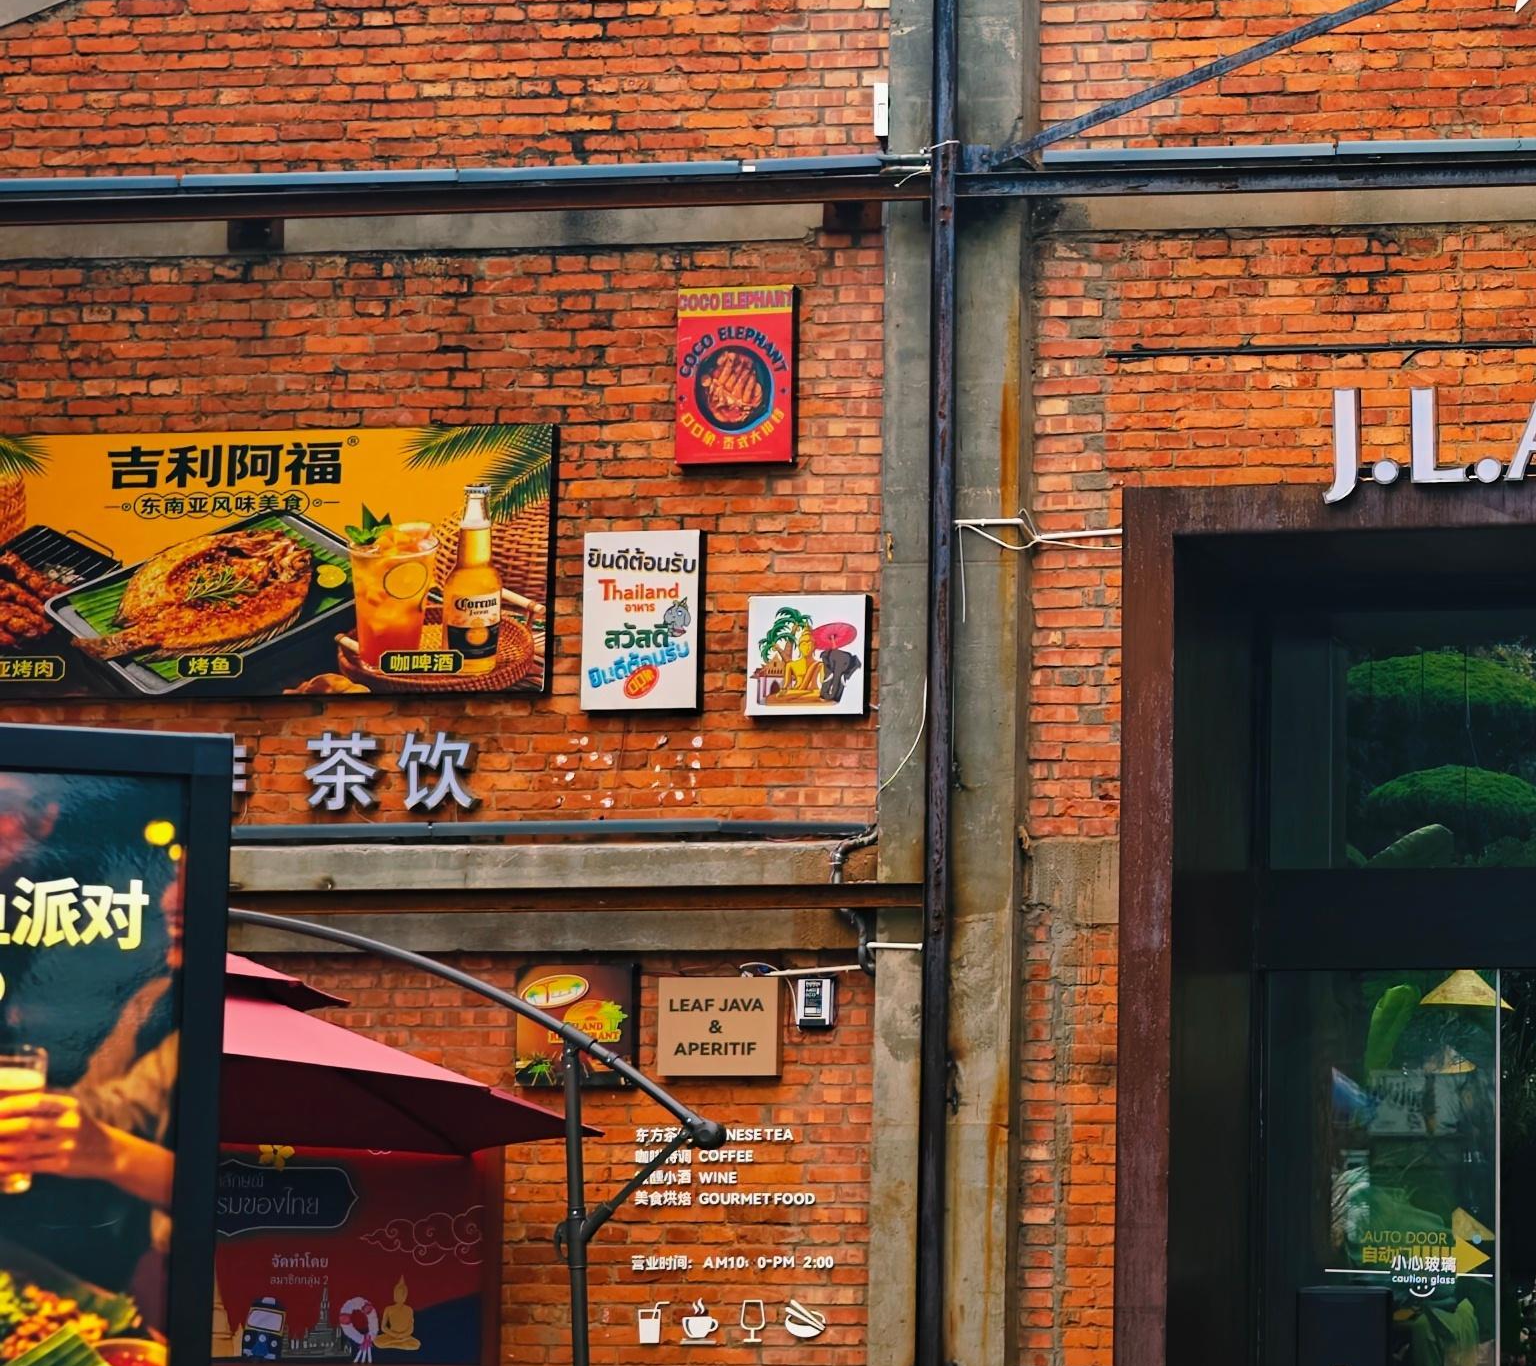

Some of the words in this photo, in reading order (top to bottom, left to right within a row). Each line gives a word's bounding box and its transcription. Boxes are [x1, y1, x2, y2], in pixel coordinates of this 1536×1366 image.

[680, 334, 715, 378] COCO
[107, 441, 343, 490] 吉利阿福
[140, 493, 304, 516] 东南亚风味美食
[588, 548, 696, 573] ยินดีต้อนรับ
[598, 579, 679, 601] Thailand
[188, 656, 231, 676] 烤鱼
[389, 653, 454, 672] 咖啤酒
[669, 999, 715, 1012] LEAF
[719, 999, 764, 1012] JAVA
[708, 1020, 723, 1034] &
[673, 1042, 757, 1056] APERITIF
[726, 1128, 763, 1142] NESE
[765, 1128, 794, 1142] TEA
[698, 1149, 754, 1163] COFFEE
[635, 1169, 692, 1185] 醺小酒
[698, 1171, 738, 1184] WINE
[634, 1190, 692, 1206] 美食烘焙
[698, 1192, 772, 1205] GOURMET
[773, 1192, 816, 1205] FOOD
[1360, 1230, 1401, 1244] AUTO
[1405, 1231, 1448, 1245] DOOR
[1391, 1255, 1457, 1273] 小心玻璃
[1391, 1274, 1428, 1284] caution
[1430, 1274, 1456, 1286] glass
